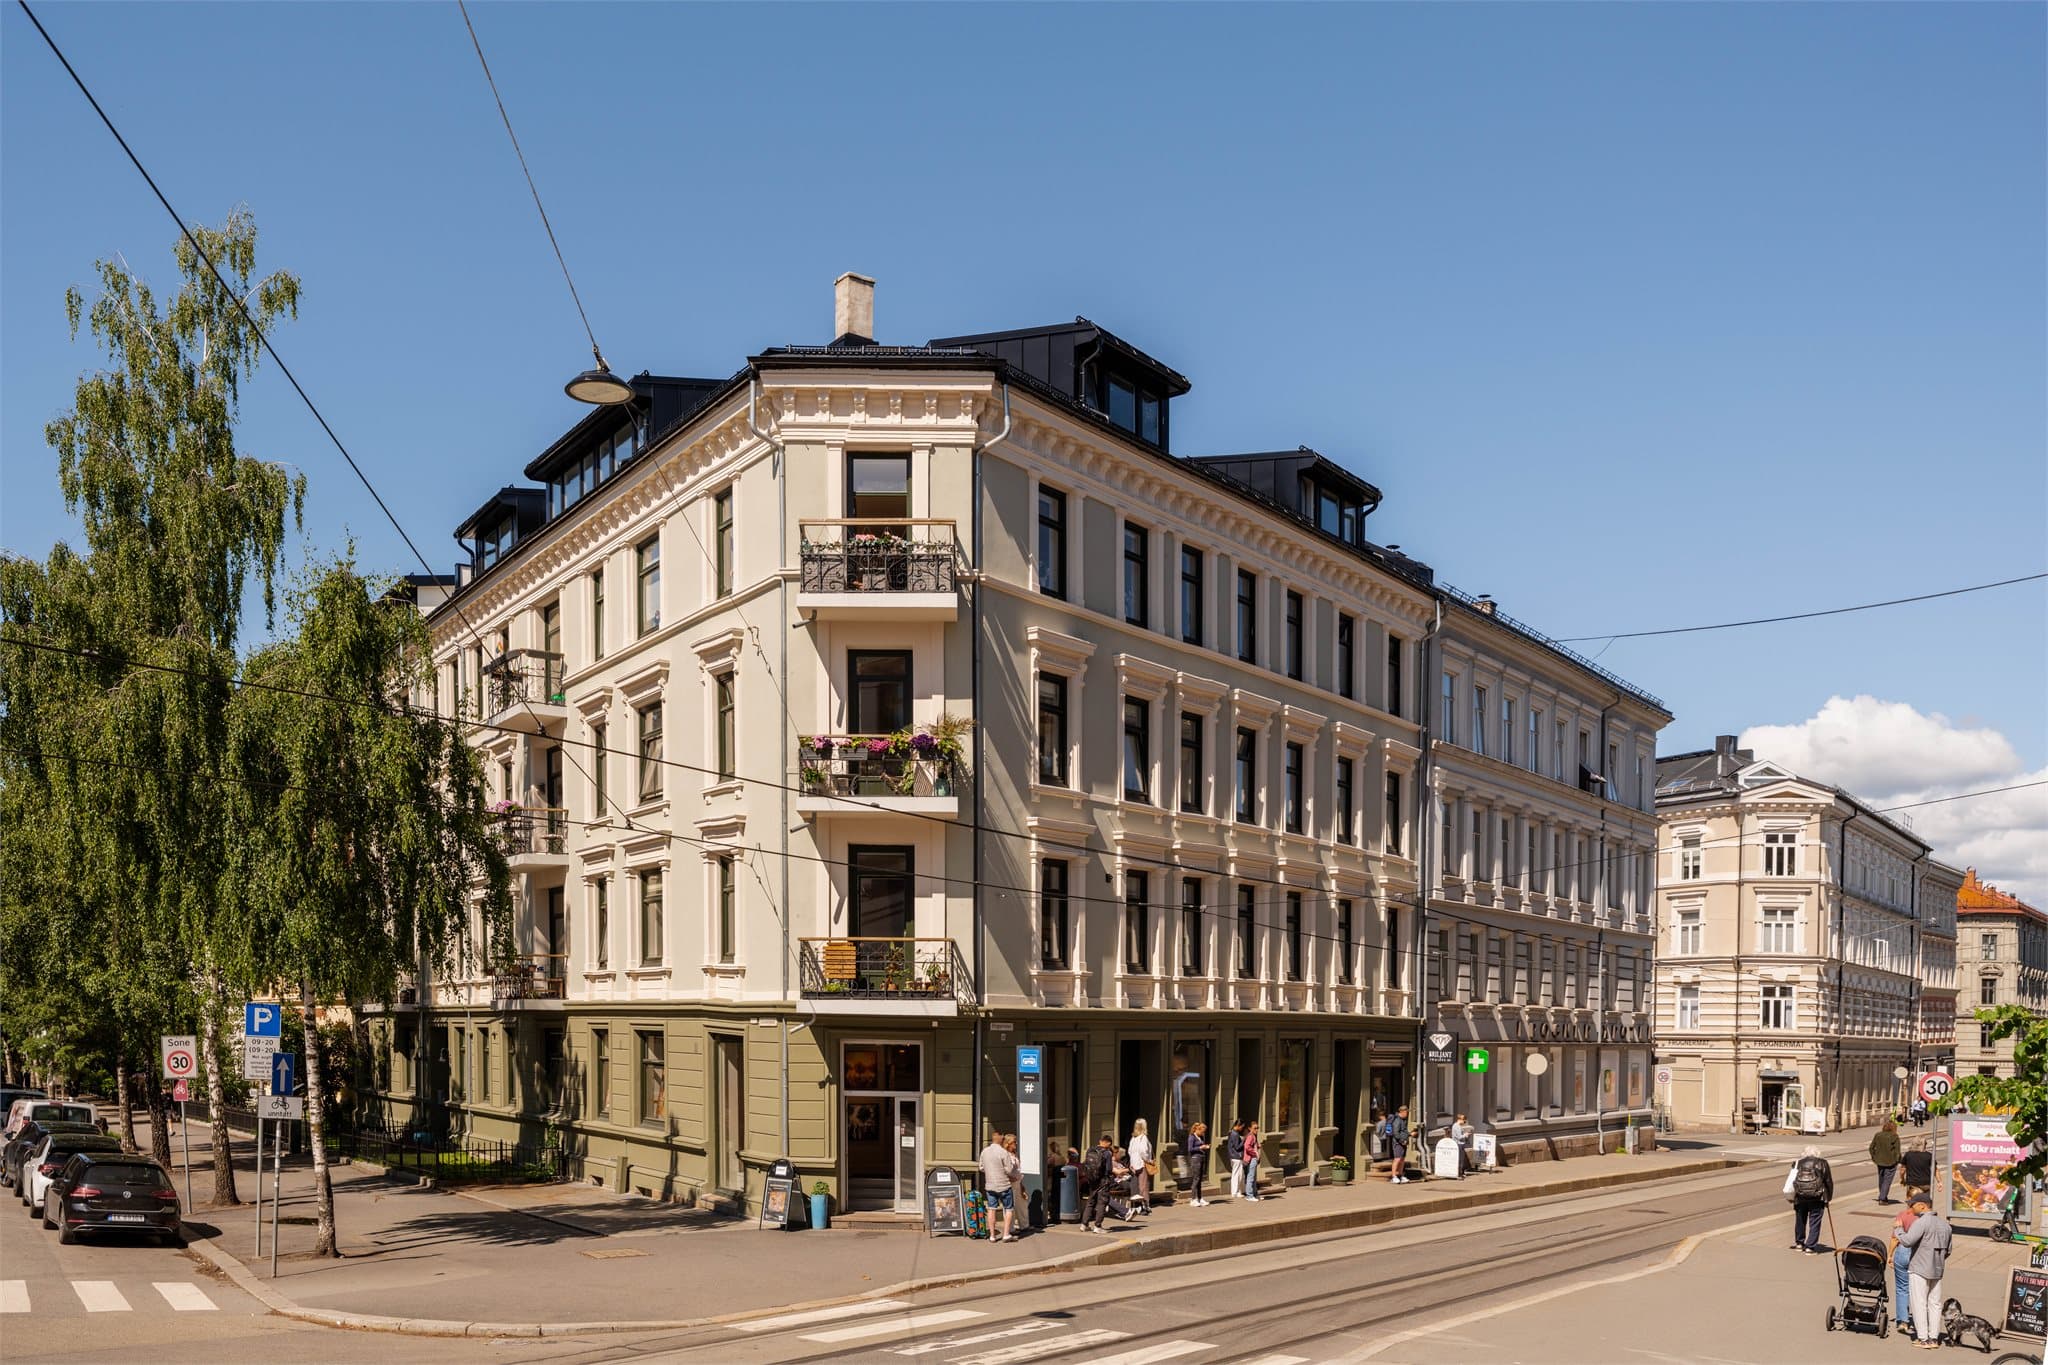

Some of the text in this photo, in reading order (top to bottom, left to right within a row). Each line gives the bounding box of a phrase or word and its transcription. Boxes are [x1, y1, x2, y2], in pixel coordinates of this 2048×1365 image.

[253, 1007, 273, 1033] P
[167, 1038, 191, 1047] Sone
[1753, 1039, 1805, 1048] FROGNERMAT
[171, 1056, 189, 1069] 30
[1925, 1079, 1949, 1096] 30
[1959, 1143, 2021, 1155] 100 kr rabatt
